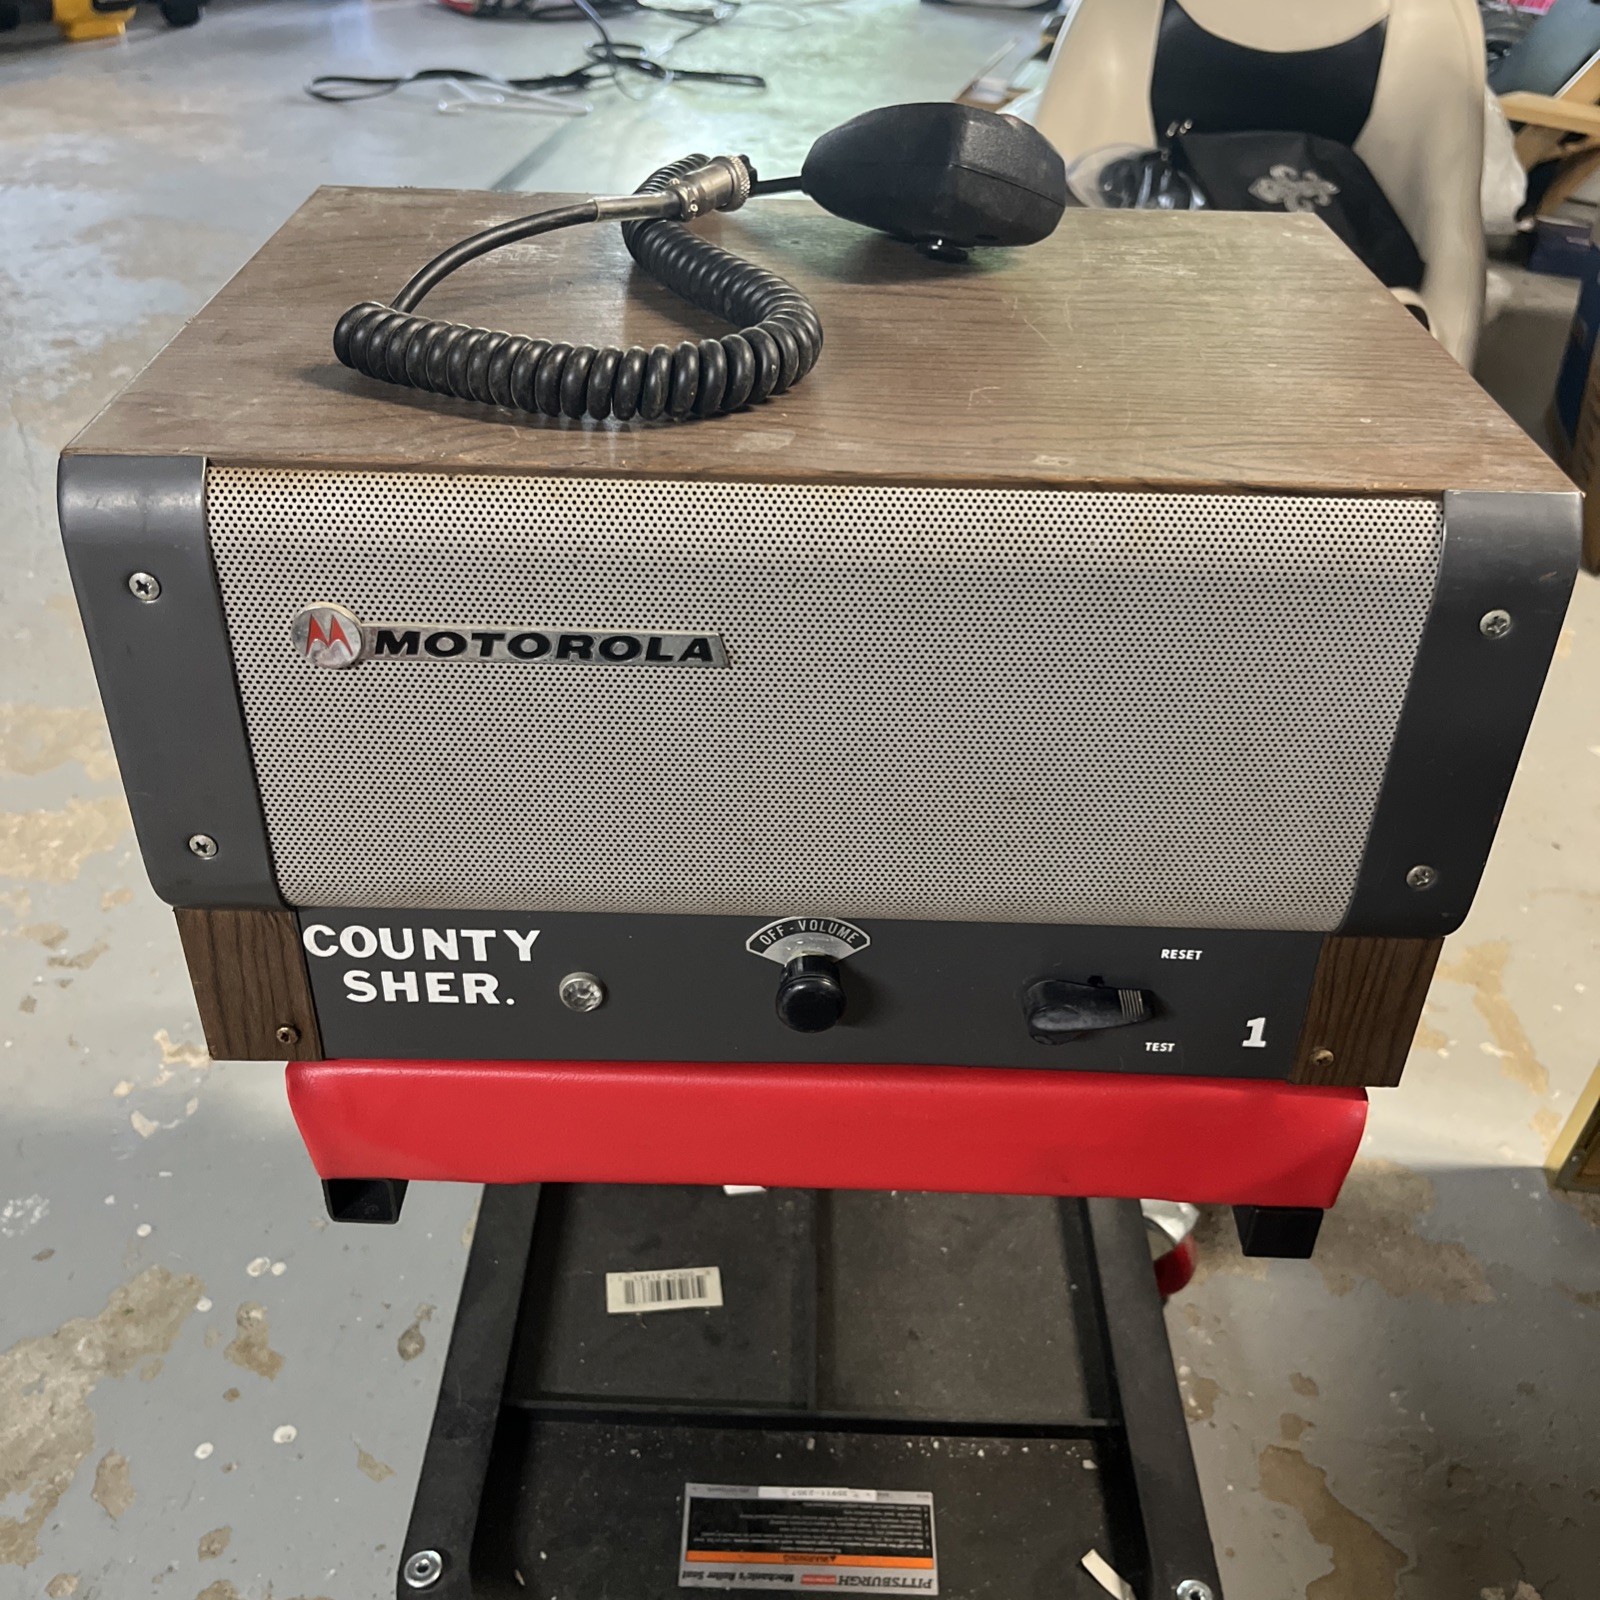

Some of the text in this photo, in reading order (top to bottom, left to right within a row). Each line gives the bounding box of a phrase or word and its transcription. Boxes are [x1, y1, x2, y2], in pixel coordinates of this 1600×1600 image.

[374, 629, 714, 663] MOTOROLA
[302, 924, 541, 963] COUNTY
[759, 924, 786, 946] OFF
[797, 919, 860, 944] VOLUME
[1160, 948, 1203, 961] RESET
[343, 969, 516, 1006] SHER.
[1144, 1041, 1176, 1053] TEST
[1241, 1017, 1267, 1048] 1
[838, 1574, 933, 1590] PITTSBURGH
